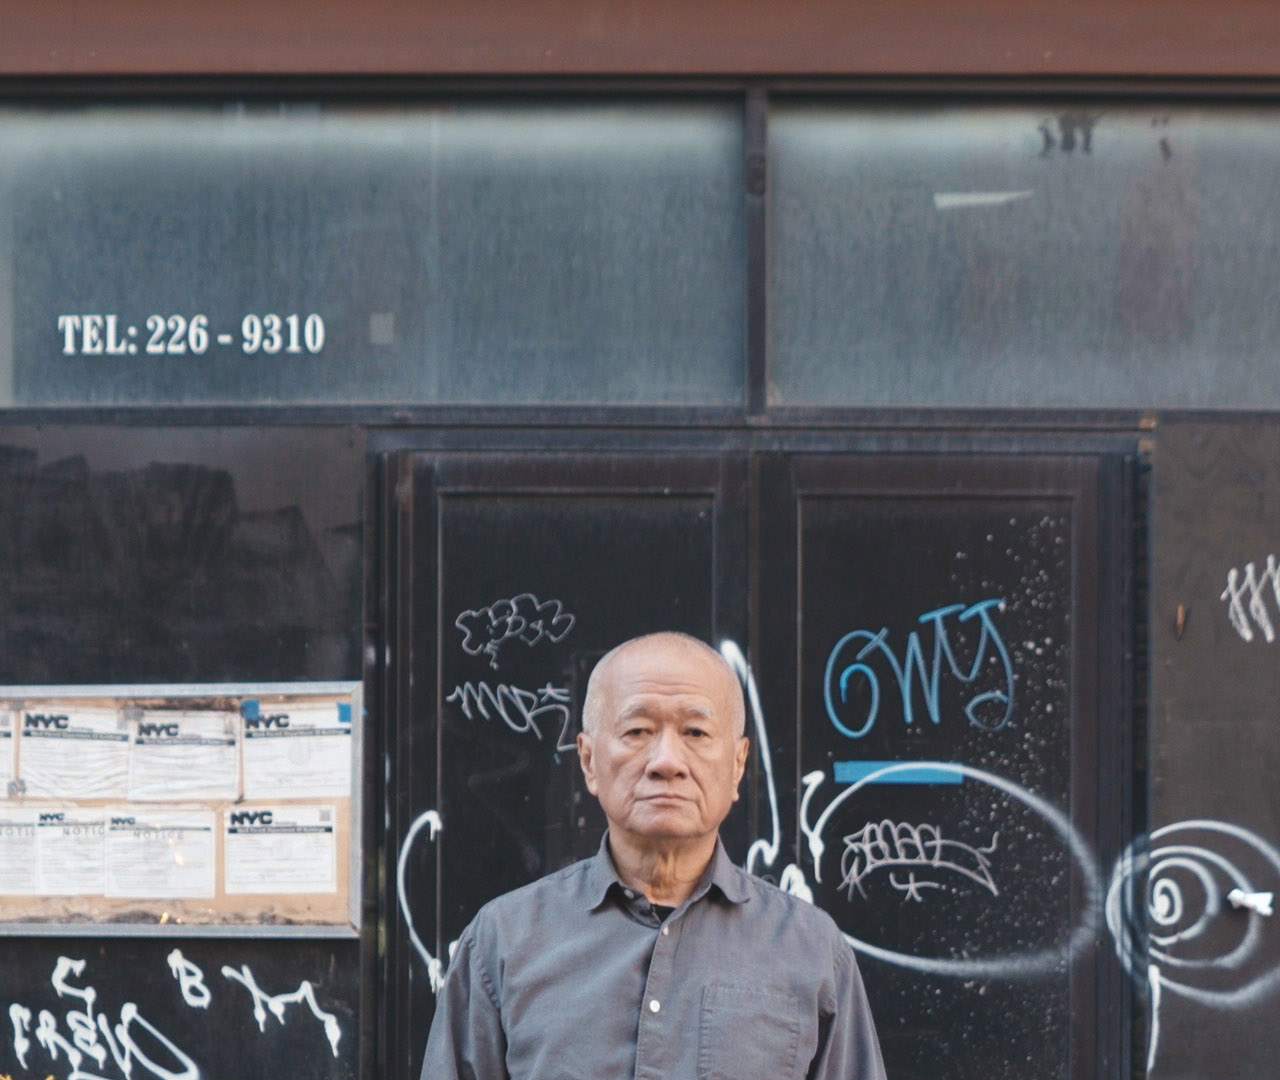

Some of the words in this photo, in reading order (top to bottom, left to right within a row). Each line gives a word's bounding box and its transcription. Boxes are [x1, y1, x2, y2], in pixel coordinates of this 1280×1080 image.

[57, 314, 138, 356] TEL:
[146, 314, 209, 355] 226
[241, 313, 326, 355] 9310
[24, 713, 69, 730] NYC
[137, 723, 180, 737] NYC
[39, 812, 65, 822] NYC
[110, 816, 136, 825] NYC
[230, 811, 273, 826] NYC
